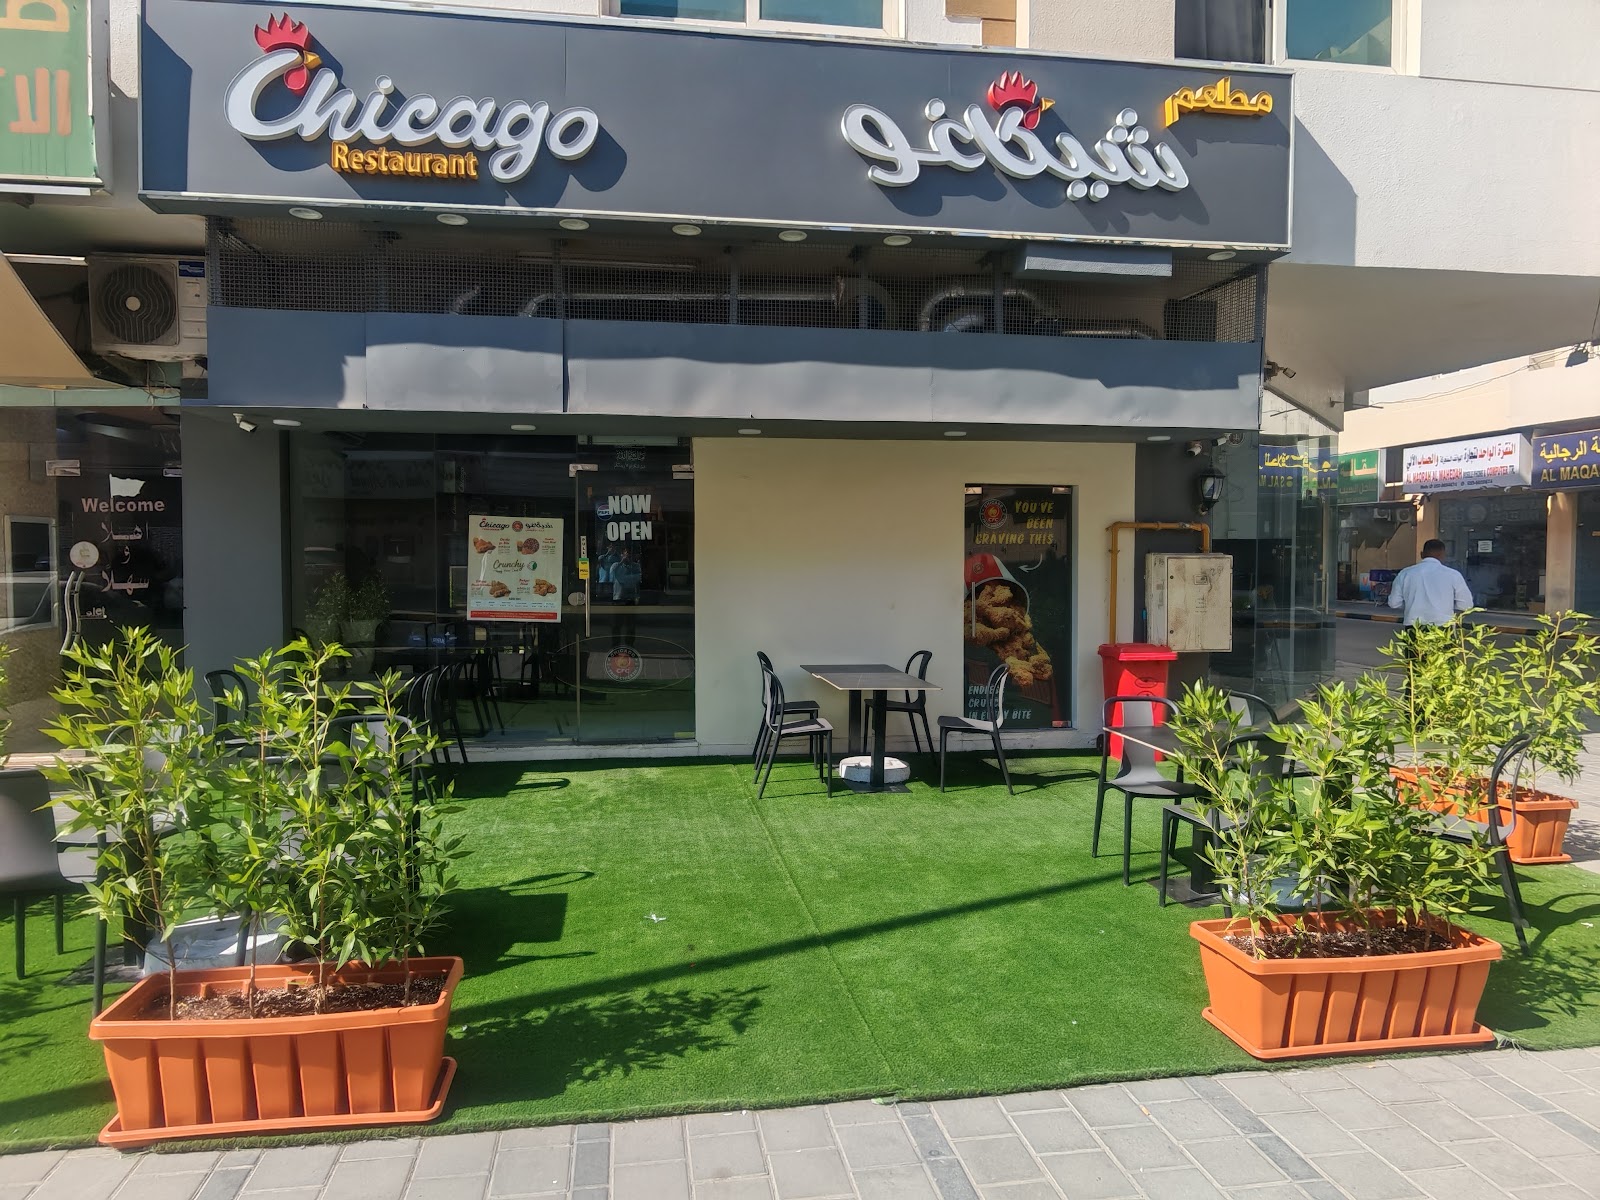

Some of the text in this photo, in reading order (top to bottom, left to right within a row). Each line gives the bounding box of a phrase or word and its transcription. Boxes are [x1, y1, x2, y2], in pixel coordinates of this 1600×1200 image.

[1164, 76, 1273, 127] مطعم
[223, 47, 599, 184] Chicago
[840, 97, 1190, 202] شيكاغو
[331, 141, 478, 180] Restaurant
[1540, 440, 1587, 463] الرجالية
[1540, 469, 1557, 483] AL
[81, 497, 165, 513] Welcome
[607, 494, 652, 515] NOW
[1015, 501, 1054, 513] YOU'VE
[479, 520, 510, 530] Chicago
[606, 521, 653, 541] OPEN
[1026, 518, 1054, 529] BEEN
[975, 533, 1054, 545] CRAVING THIS
[493, 559, 526, 571] Crunchy
[1012, 710, 1032, 720] BITE
